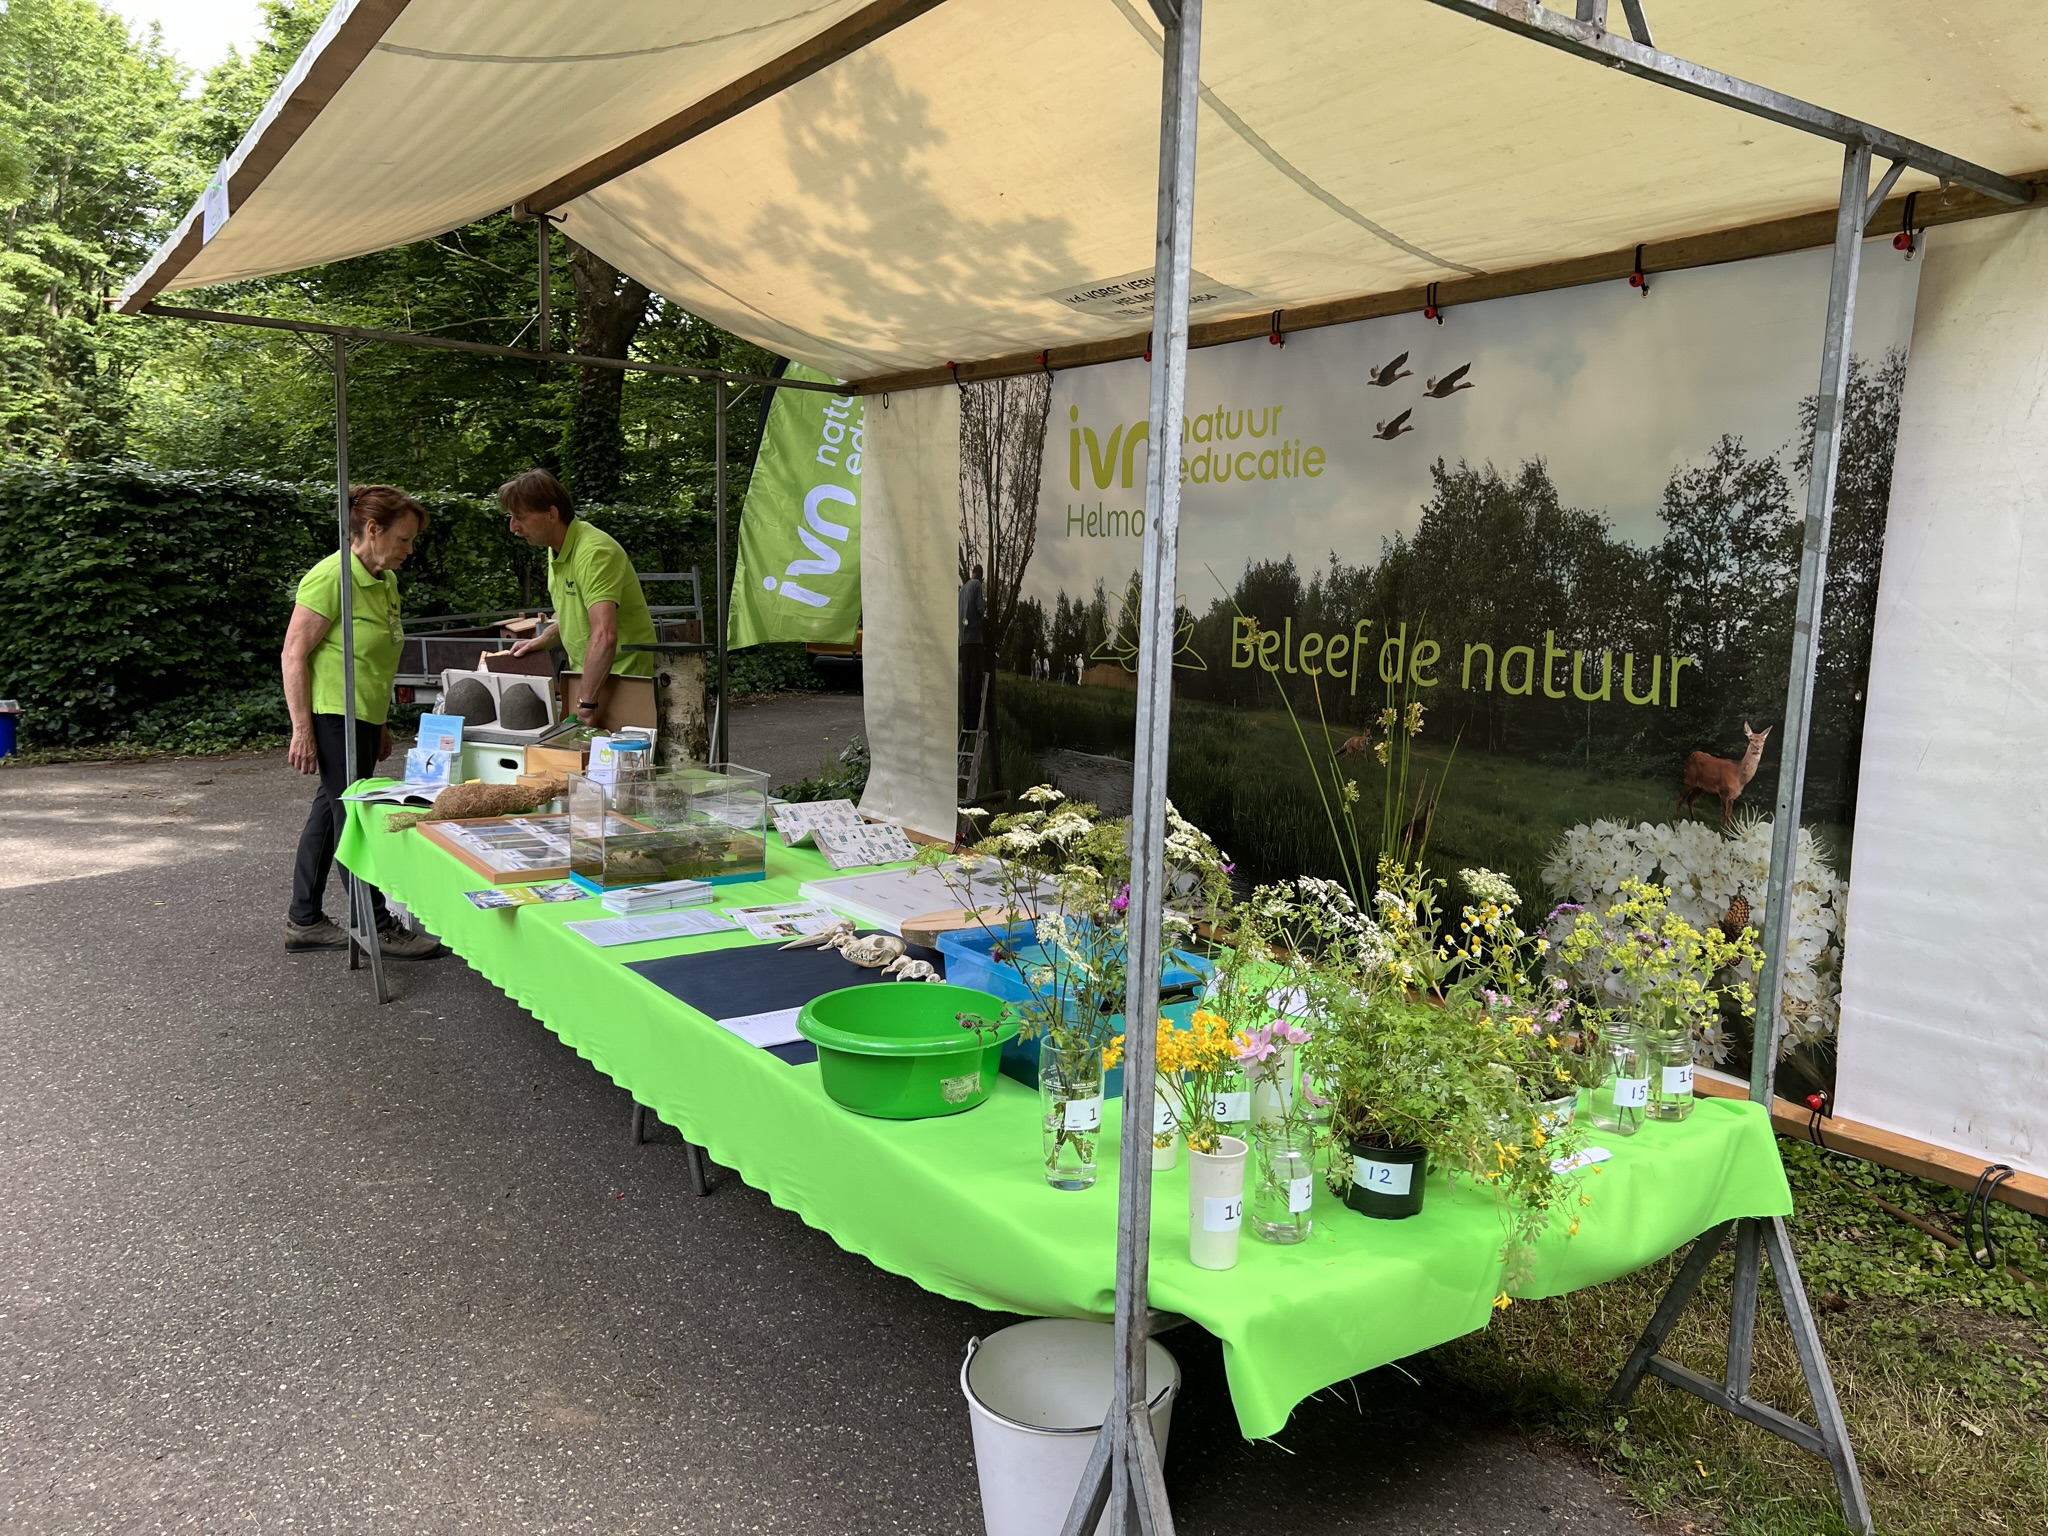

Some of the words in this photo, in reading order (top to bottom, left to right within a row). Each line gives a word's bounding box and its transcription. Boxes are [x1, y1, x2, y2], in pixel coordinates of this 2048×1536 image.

[1082, 285, 1127, 300] VORST
[1112, 291, 1155, 306] HELMO
[1066, 501, 1145, 538] Helmo
[763, 483, 857, 608] ivn
[1231, 616, 1372, 696] Beleef
[1379, 622, 1441, 687] de
[1462, 629, 1693, 708] natuur
[1631, 1085, 1647, 1100] 15
[1216, 1101, 1227, 1116] 3
[1162, 1111, 1173, 1126] 2
[1369, 1166, 1393, 1185] 12
[1224, 1200, 1243, 1221] 10
